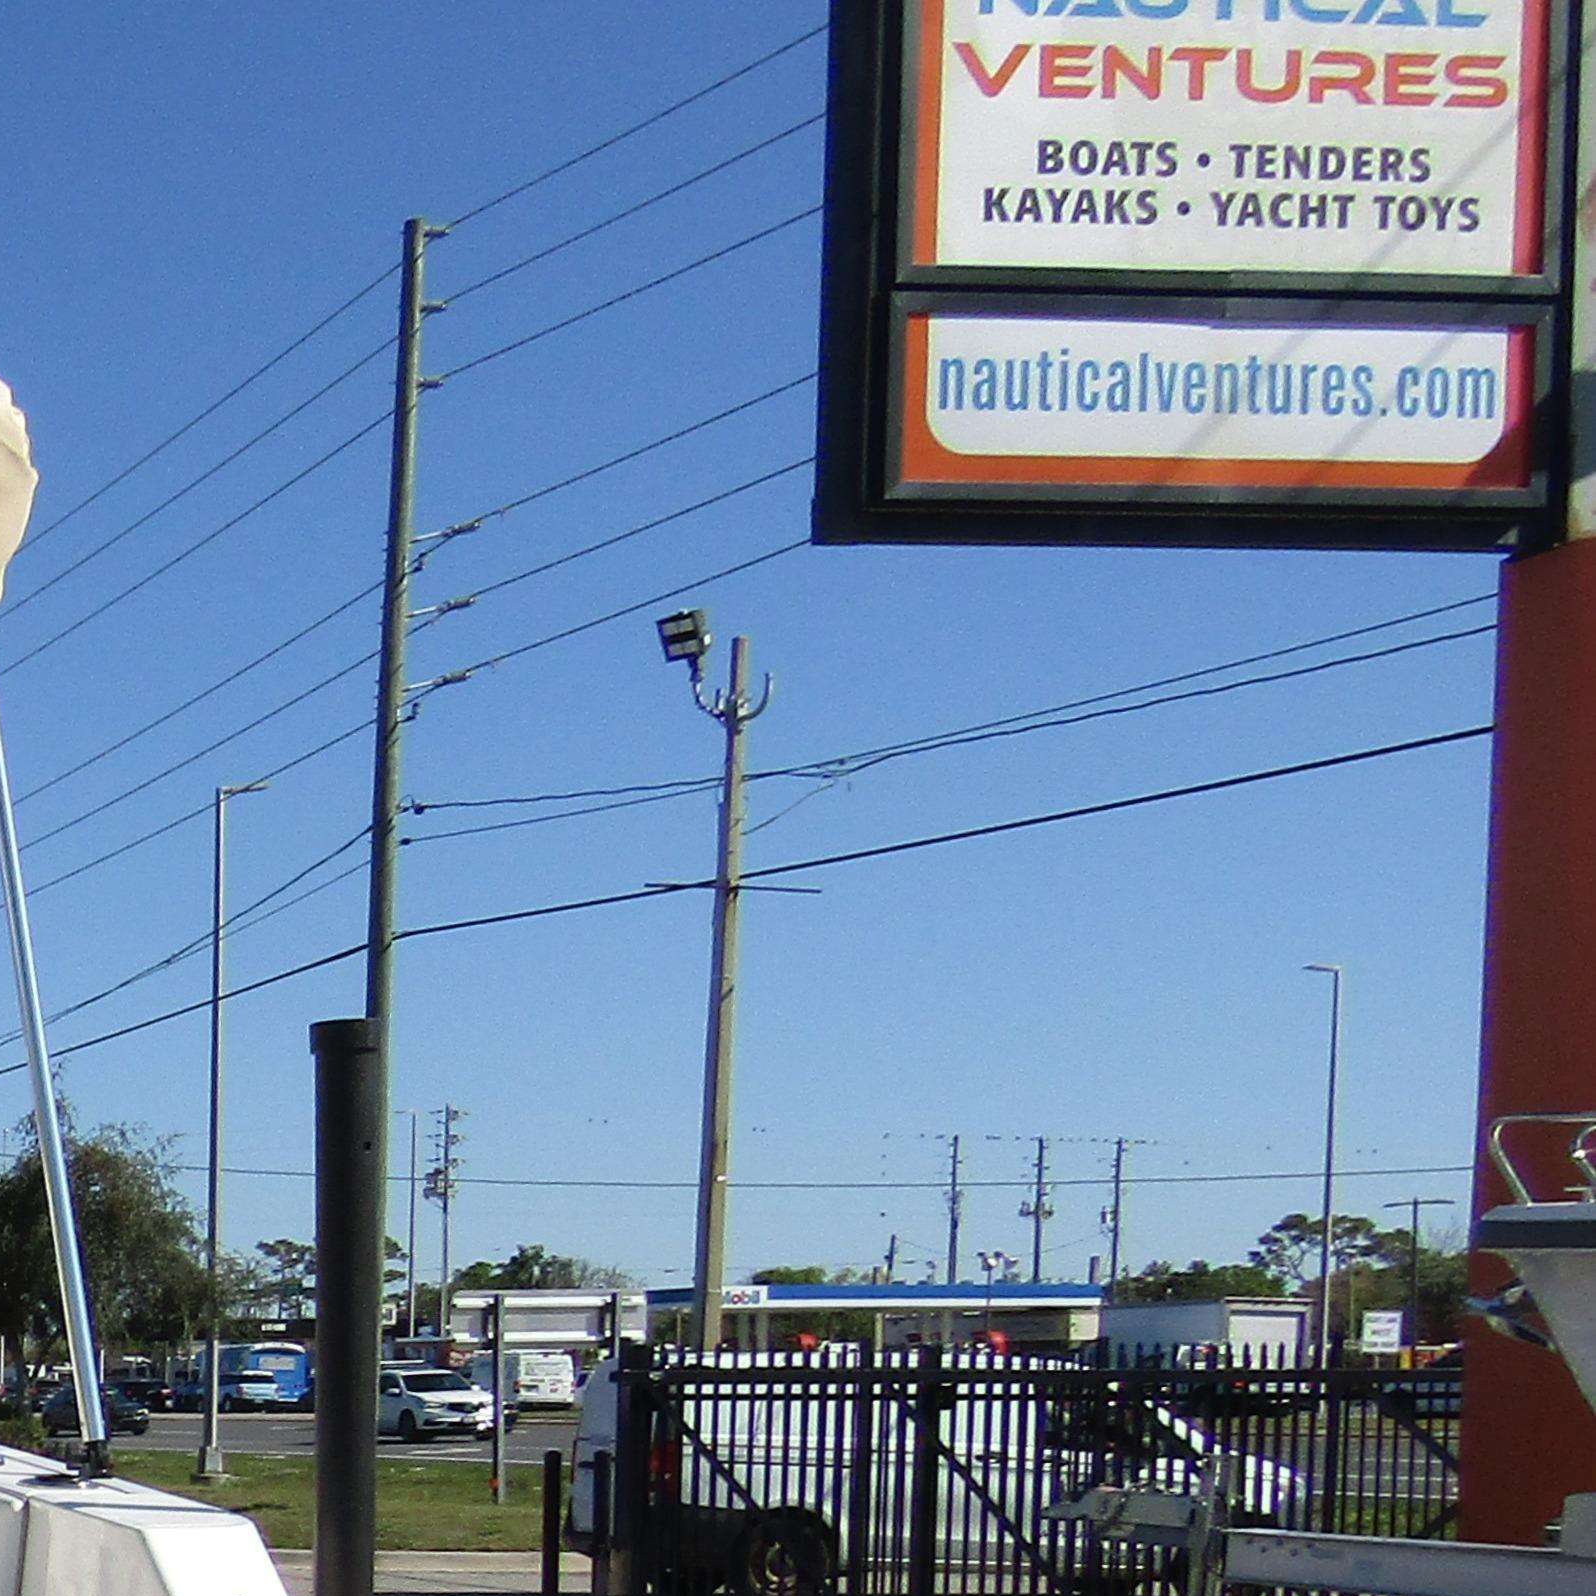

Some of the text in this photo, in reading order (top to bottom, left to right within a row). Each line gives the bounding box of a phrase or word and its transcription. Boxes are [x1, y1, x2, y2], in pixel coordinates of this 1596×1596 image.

[952, 42, 1508, 109] VENTURES
[1037, 139, 1432, 184] BOATS TENDERS
[982, 187, 1481, 233] KAYAKS YACHT TOYS
[938, 348, 1496, 420] nauticalventures.com
